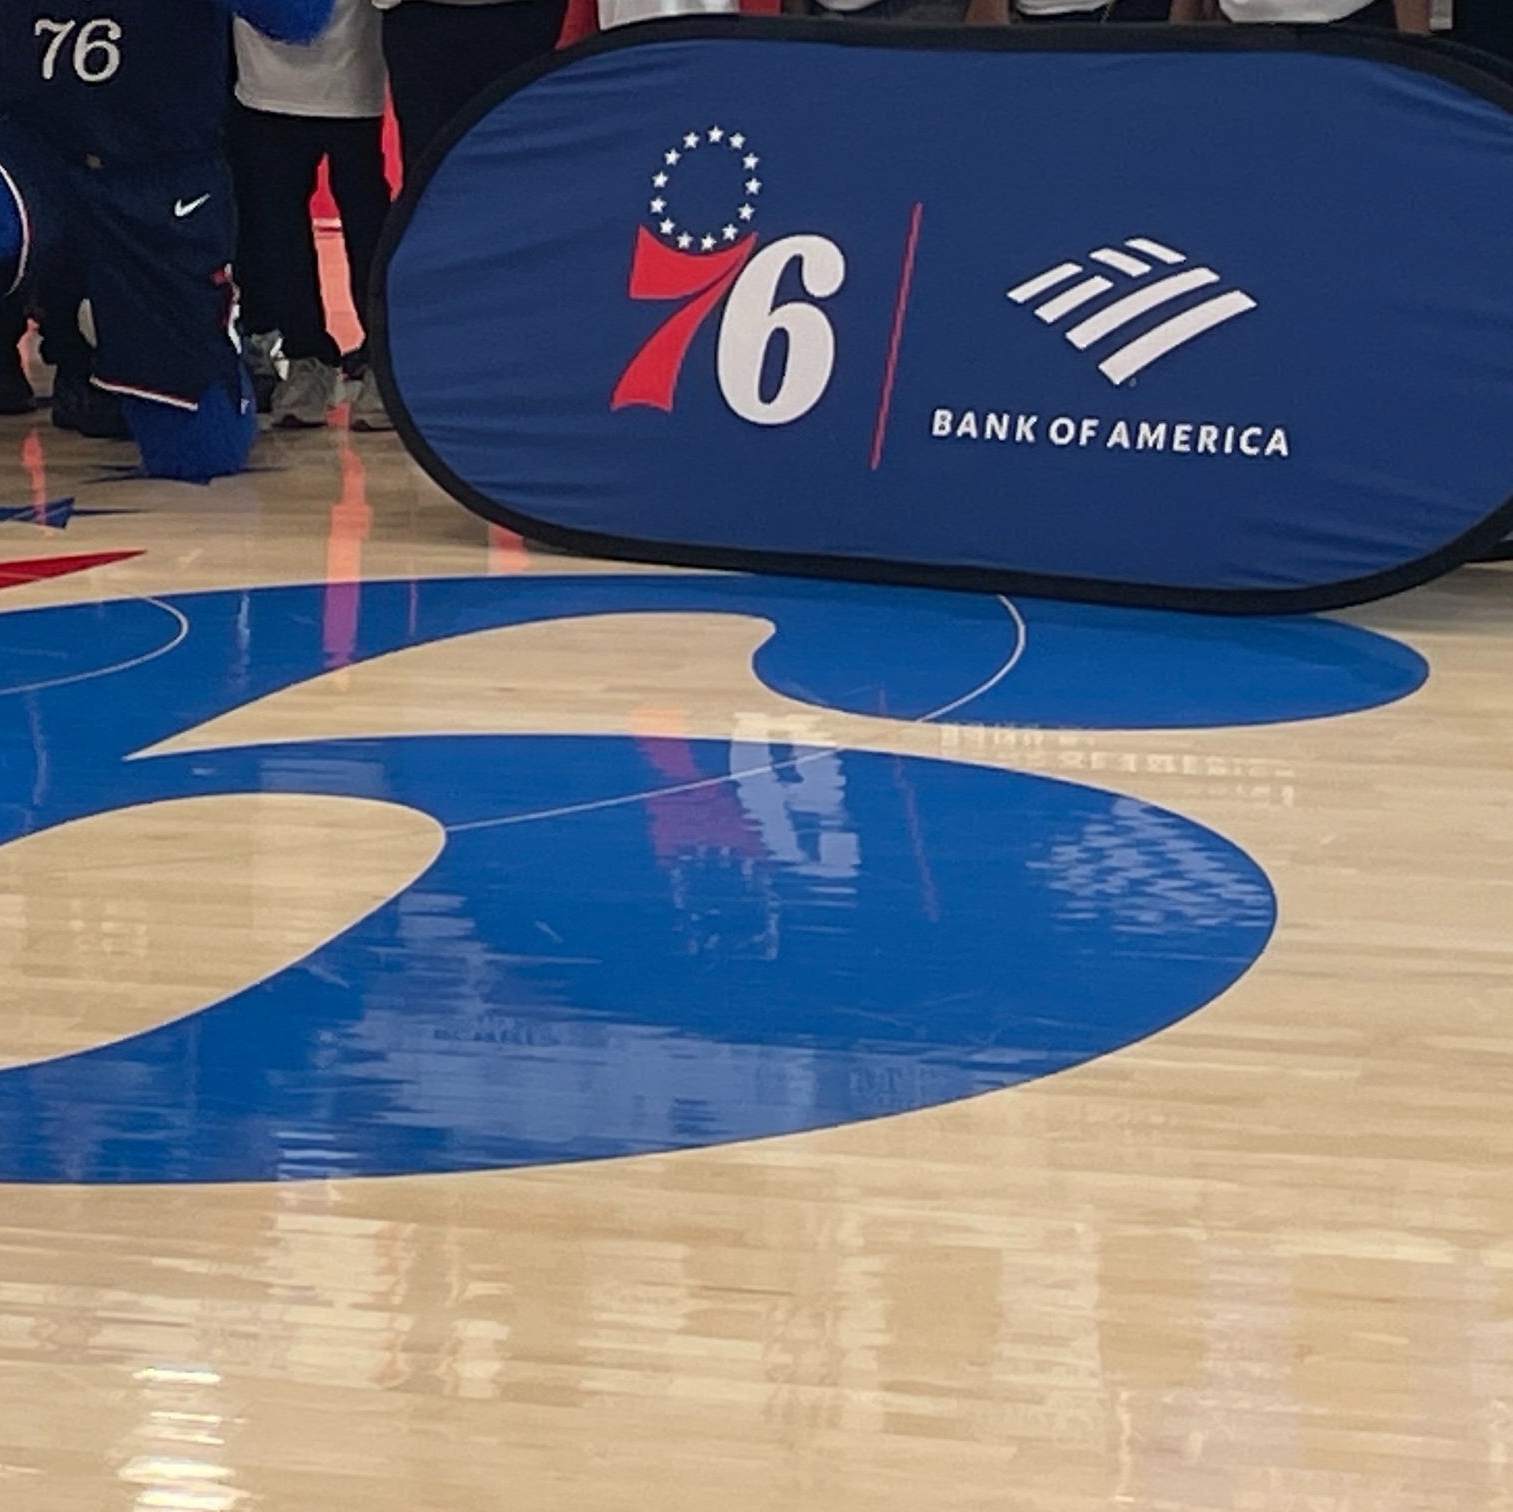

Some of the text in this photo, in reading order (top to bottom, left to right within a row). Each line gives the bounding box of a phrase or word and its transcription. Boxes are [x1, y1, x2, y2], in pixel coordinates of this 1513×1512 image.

[34, 17, 123, 83] 76
[609, 224, 847, 427] 76
[931, 408, 1290, 457] BANK OF AMERICA
